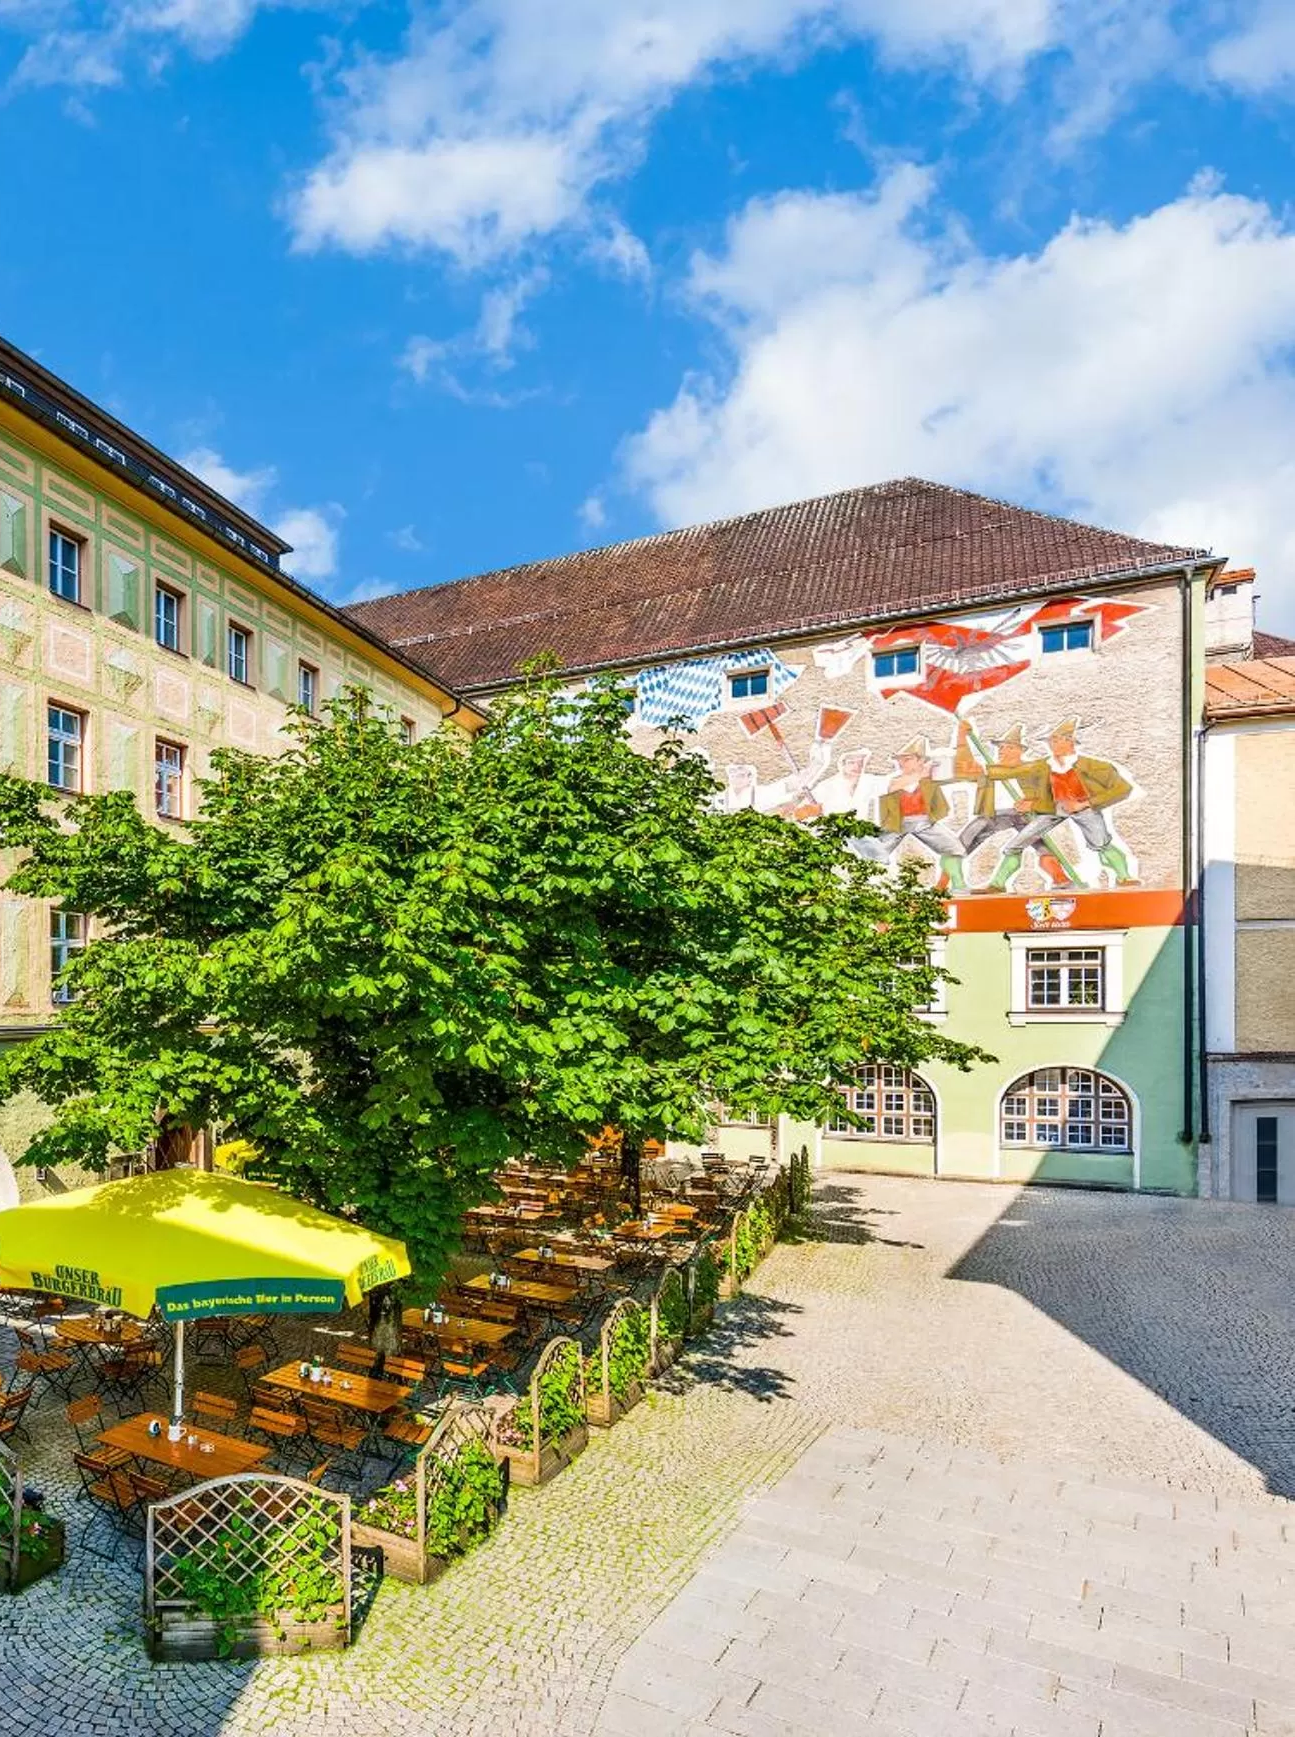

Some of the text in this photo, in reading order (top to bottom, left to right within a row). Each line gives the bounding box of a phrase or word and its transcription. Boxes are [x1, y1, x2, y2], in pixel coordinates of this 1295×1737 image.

[55, 1264, 100, 1286] UNSER
[166, 1301, 189, 1313] Das
[295, 1294, 336, 1304] Person
